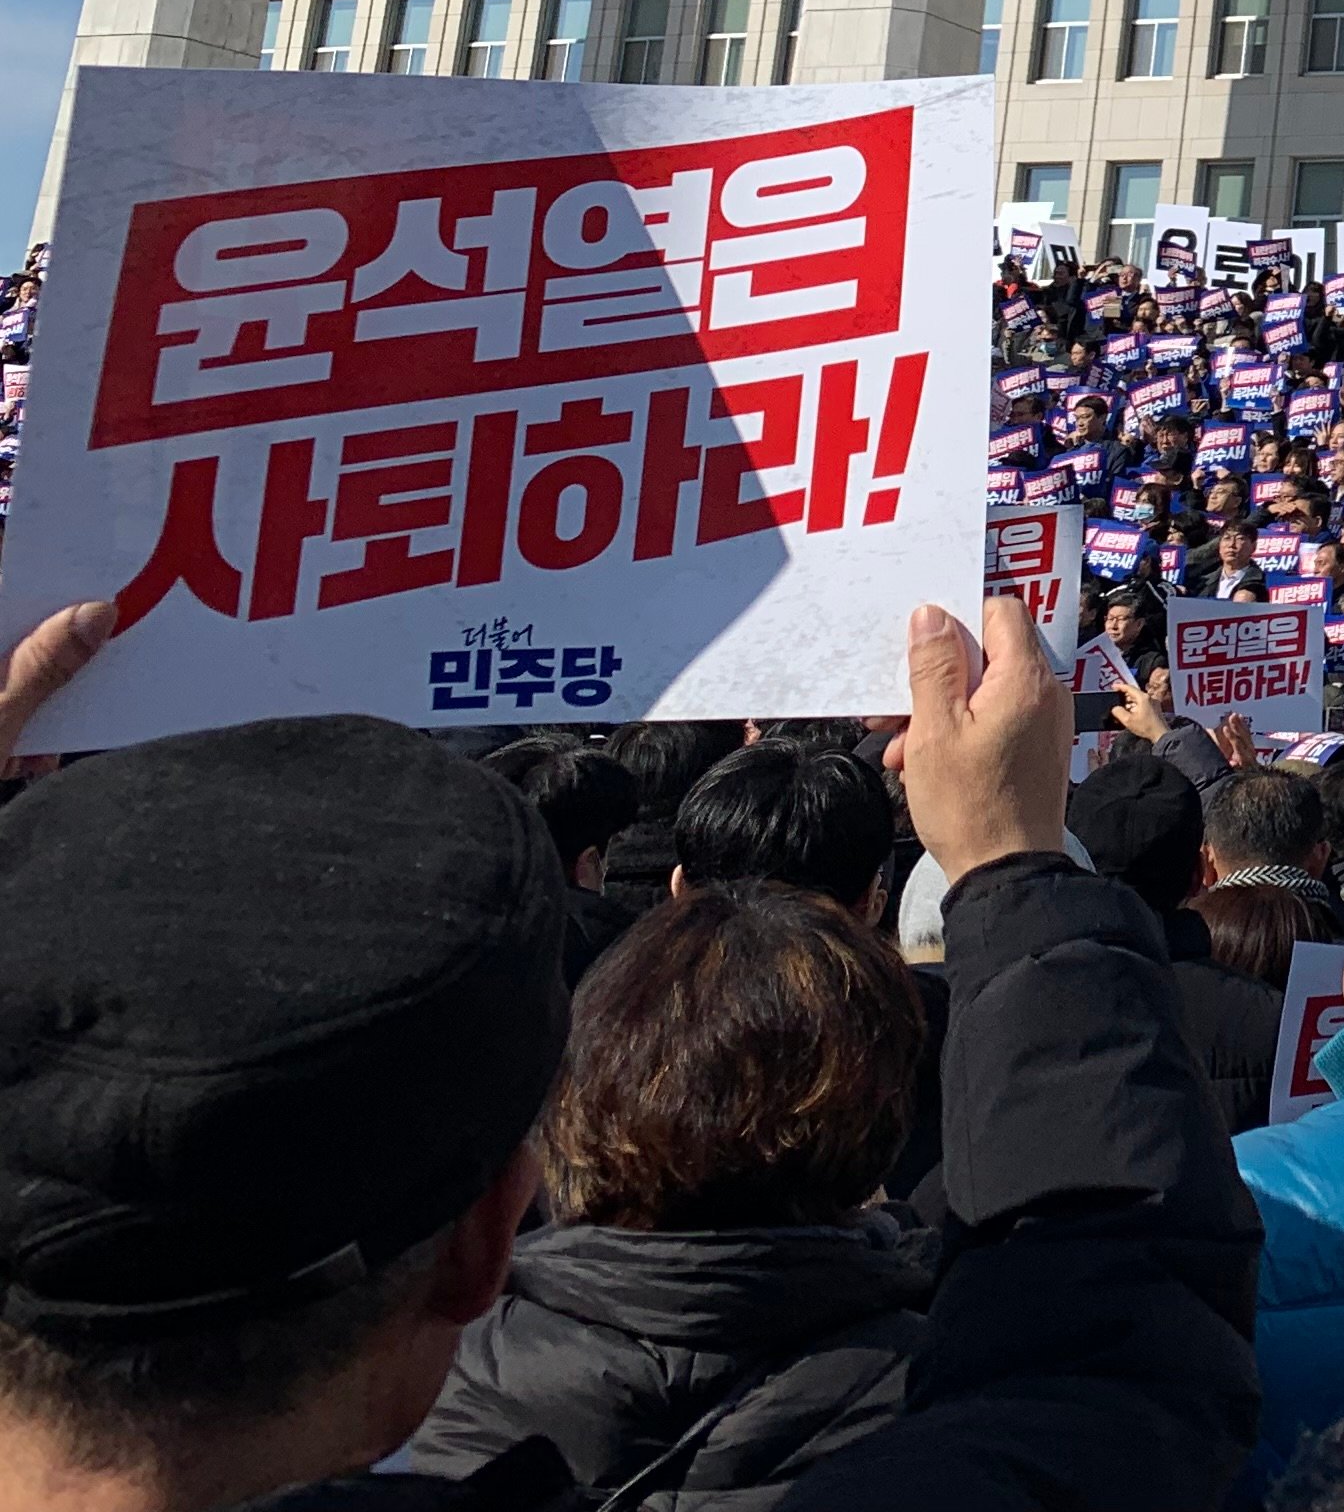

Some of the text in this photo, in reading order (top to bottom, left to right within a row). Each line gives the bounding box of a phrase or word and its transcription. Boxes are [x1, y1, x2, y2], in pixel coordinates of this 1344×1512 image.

[152, 145, 867, 405] 윤석열은
[112, 352, 930, 638] 사퇴하라!
[461, 618, 535, 651] 더불어
[1182, 614, 1301, 662] 윤석열은
[428, 647, 623, 711] 민주당
[1184, 661, 1311, 705] 사퇴하라!
